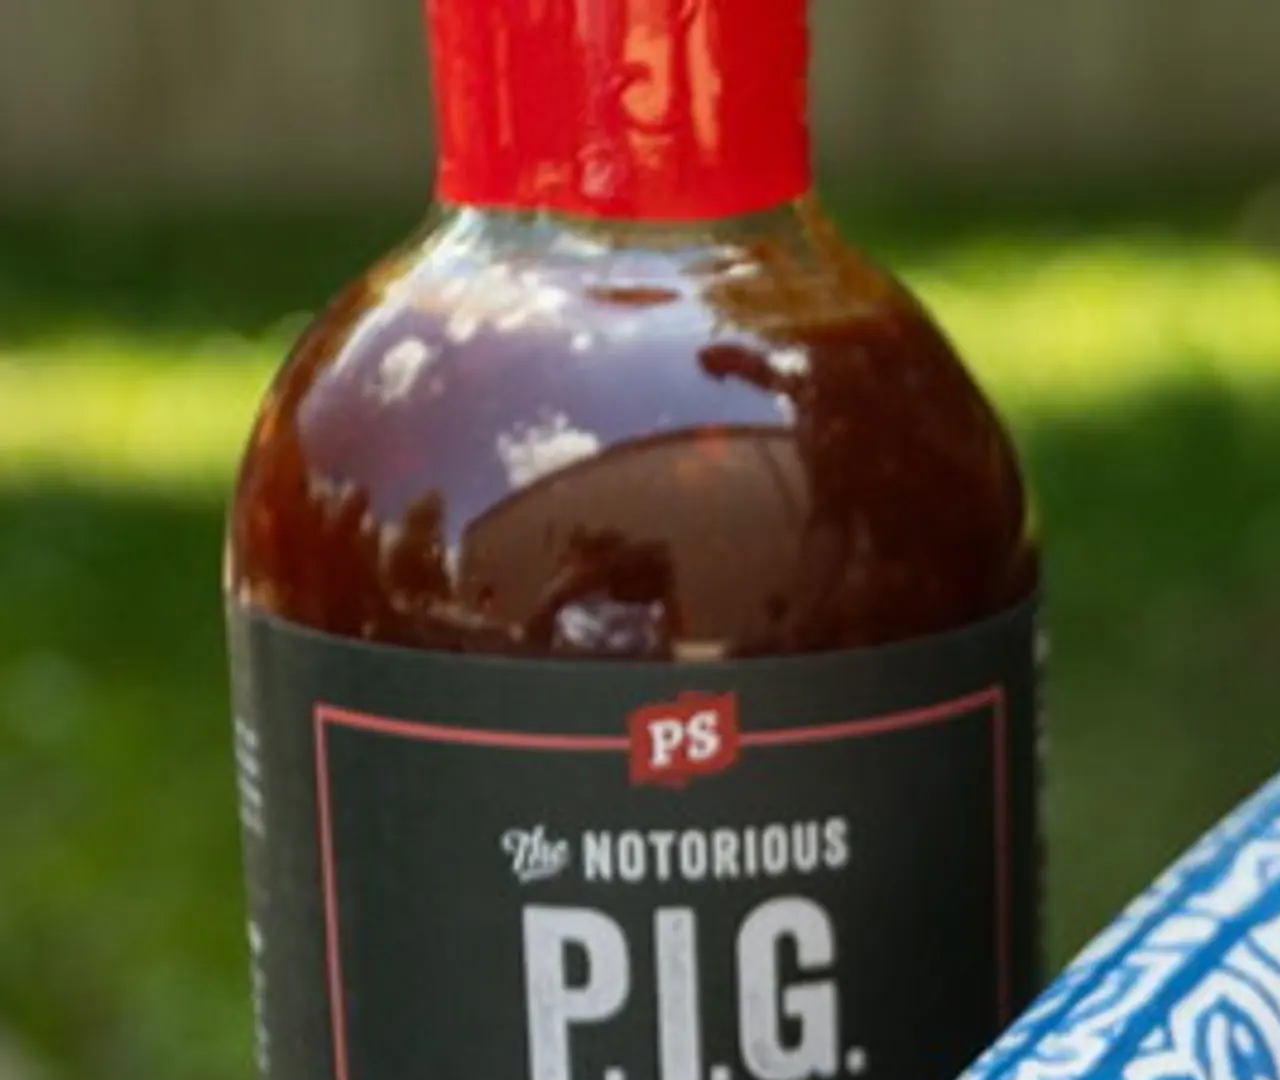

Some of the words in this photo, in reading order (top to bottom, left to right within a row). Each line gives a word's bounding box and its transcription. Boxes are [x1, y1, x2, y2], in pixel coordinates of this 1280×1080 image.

[647, 709, 721, 769] PS
[502, 823, 570, 884] The
[581, 815, 850, 881] NOTORIOUS
